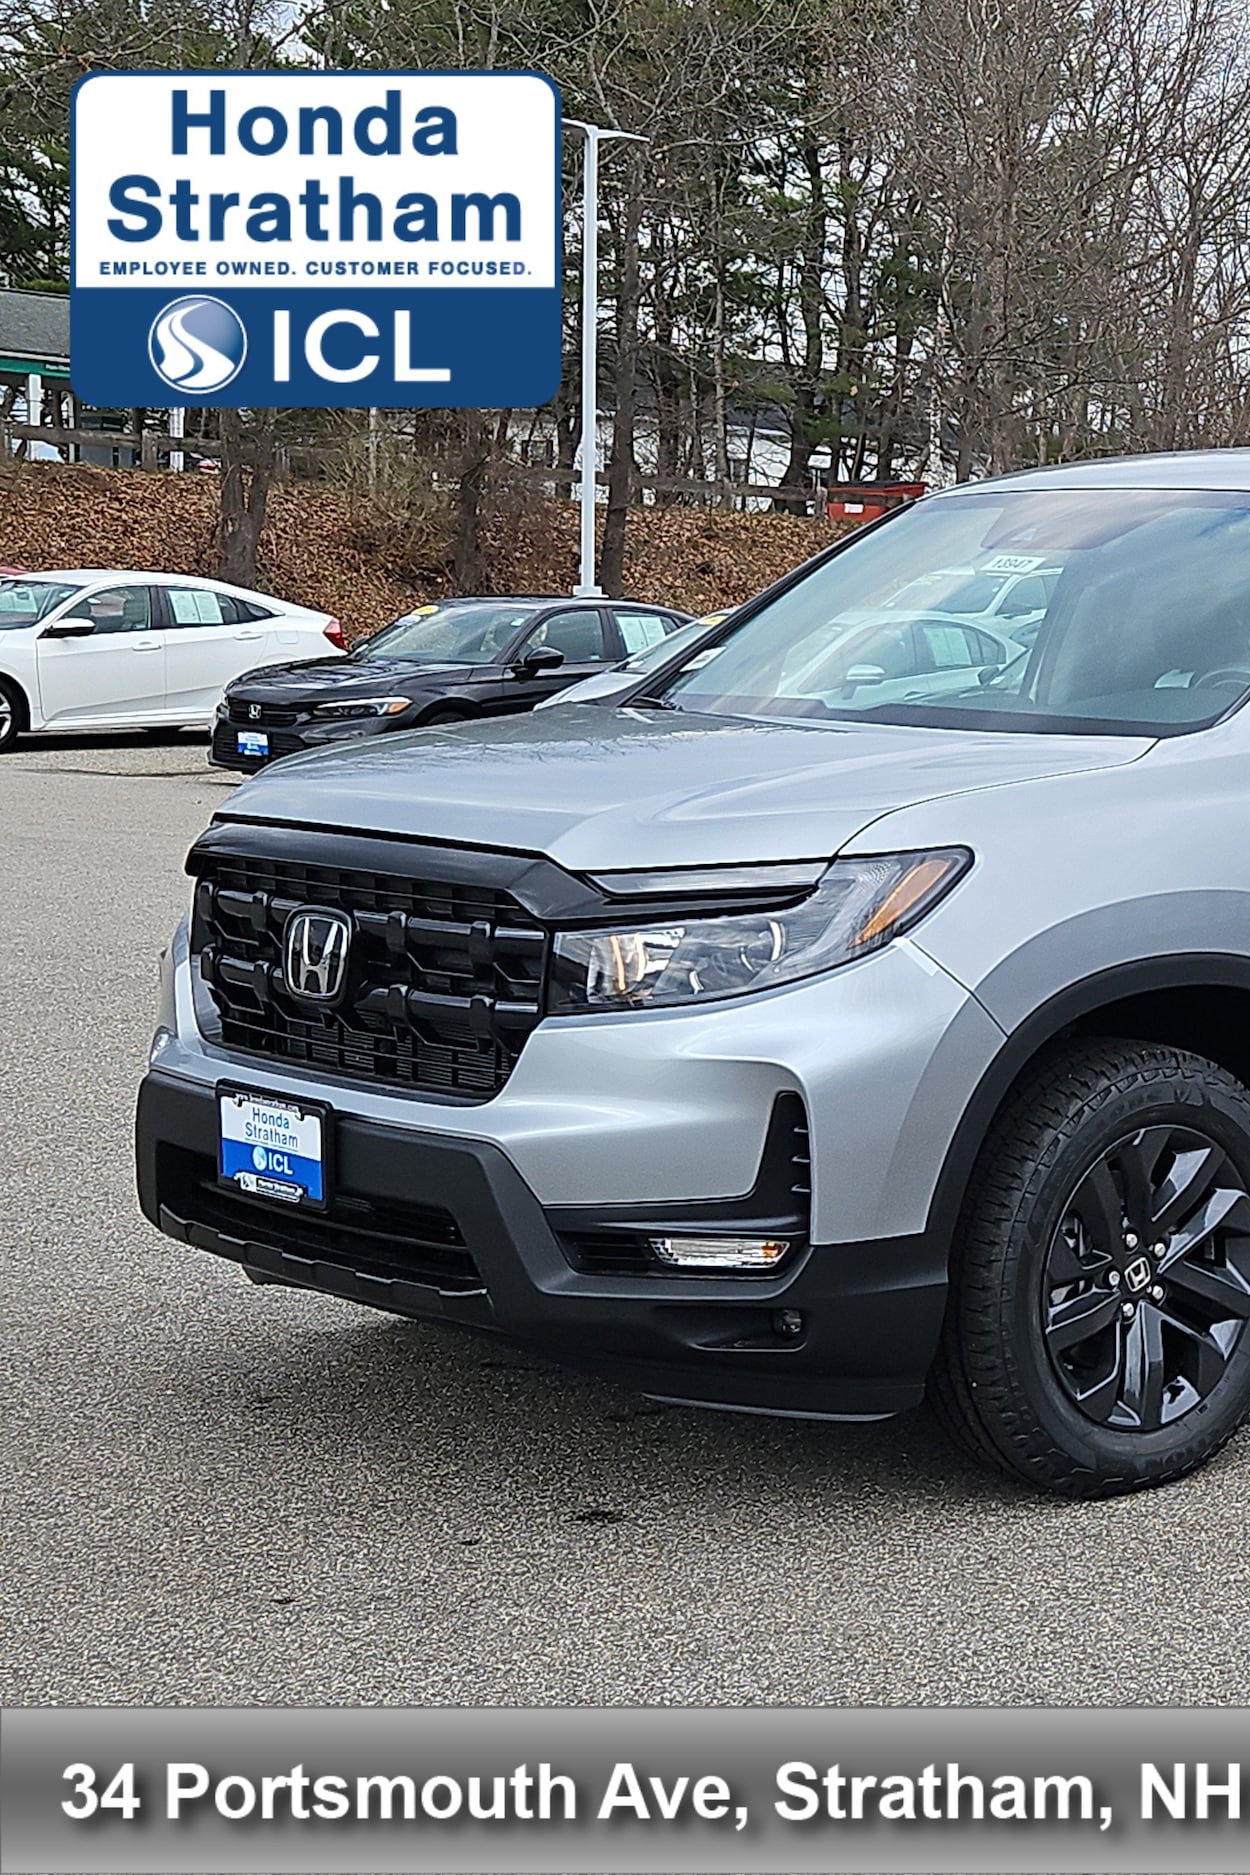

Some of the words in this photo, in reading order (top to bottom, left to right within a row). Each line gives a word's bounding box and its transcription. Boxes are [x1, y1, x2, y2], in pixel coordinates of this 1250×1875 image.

[252, 1106, 290, 1130] Honda
[245, 1122, 299, 1149] Stratham
[268, 1152, 294, 1175] ICL
